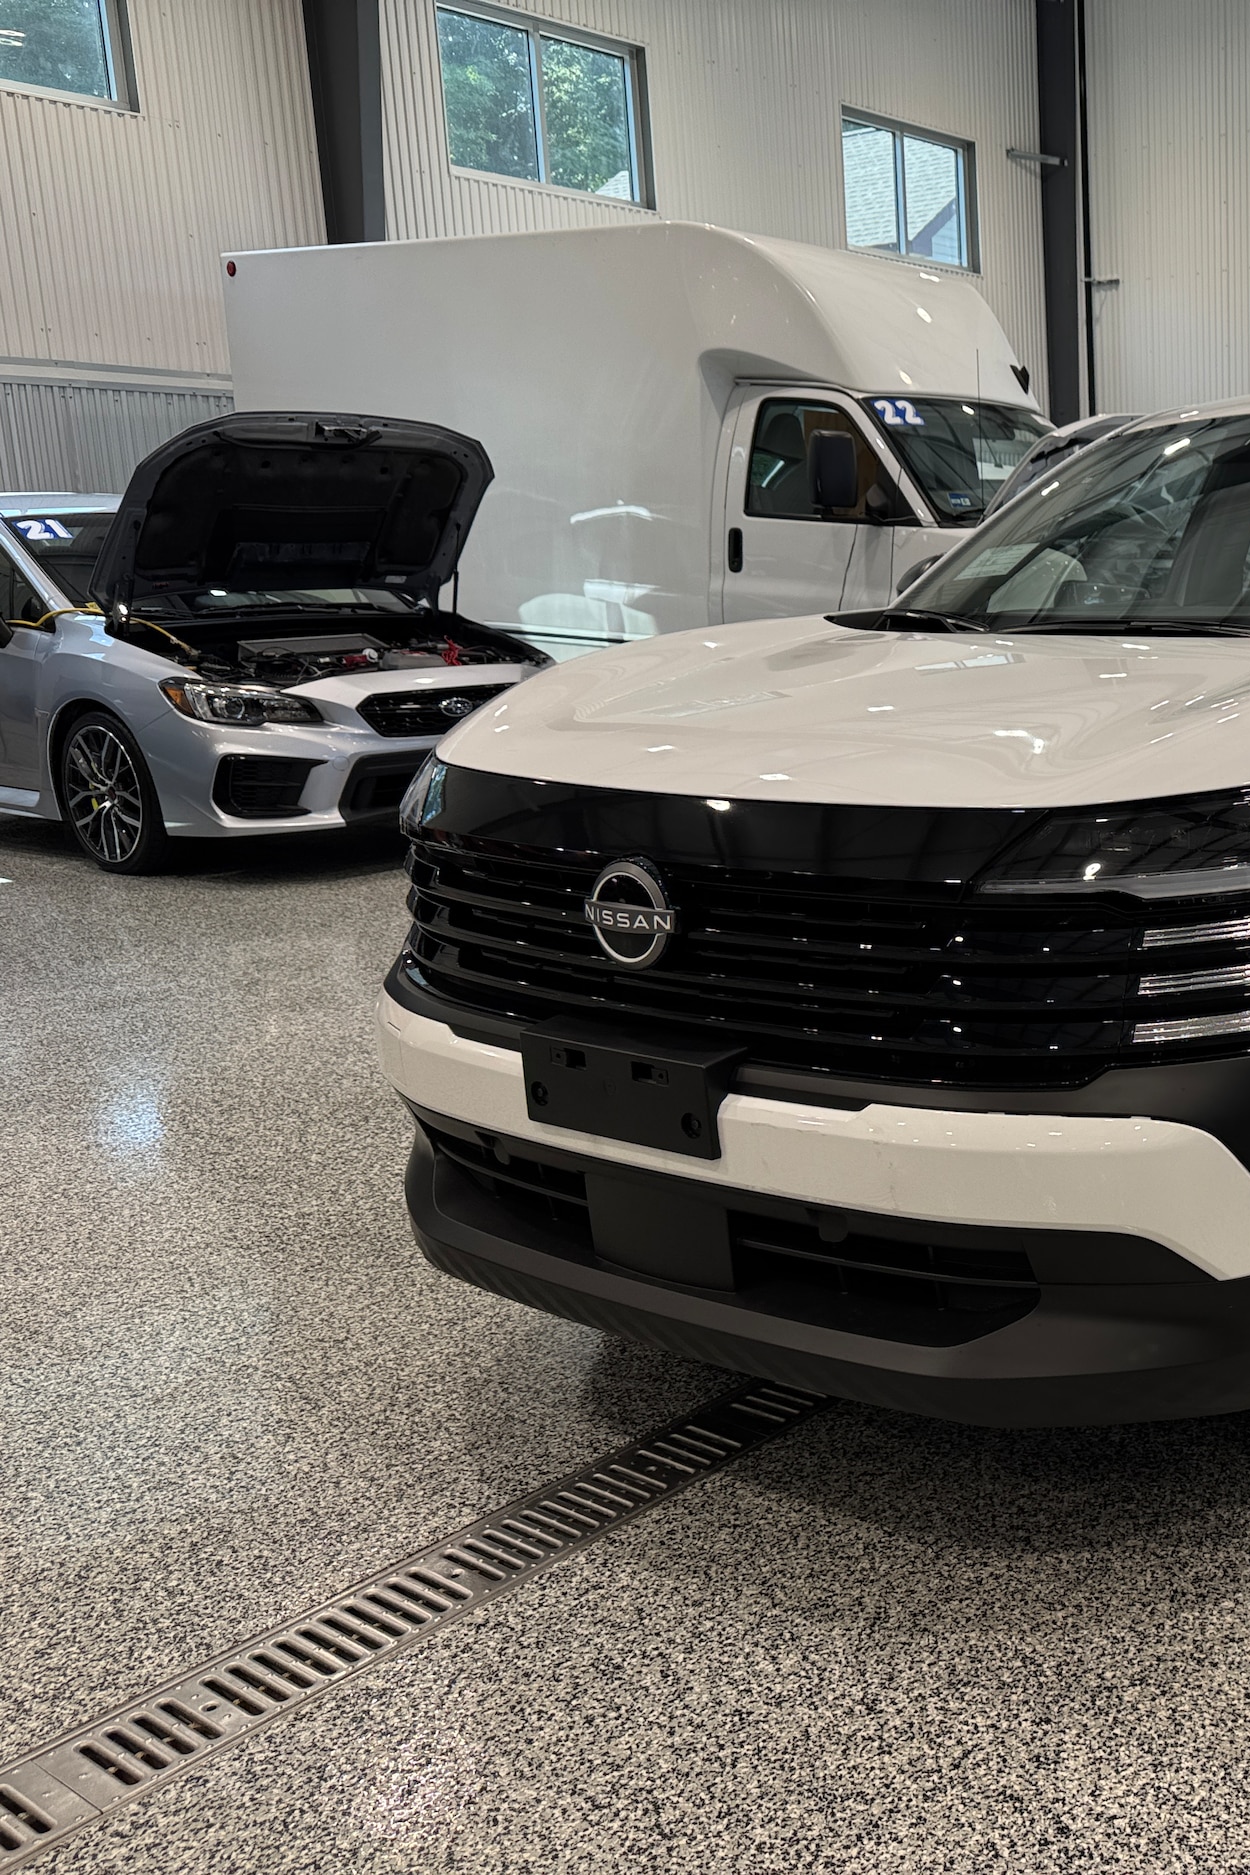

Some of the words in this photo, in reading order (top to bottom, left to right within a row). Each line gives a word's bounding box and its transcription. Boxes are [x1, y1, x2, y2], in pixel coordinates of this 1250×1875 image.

[873, 399, 925, 425] 22
[16, 519, 73, 540] 21
[585, 903, 671, 930] NISSAN
